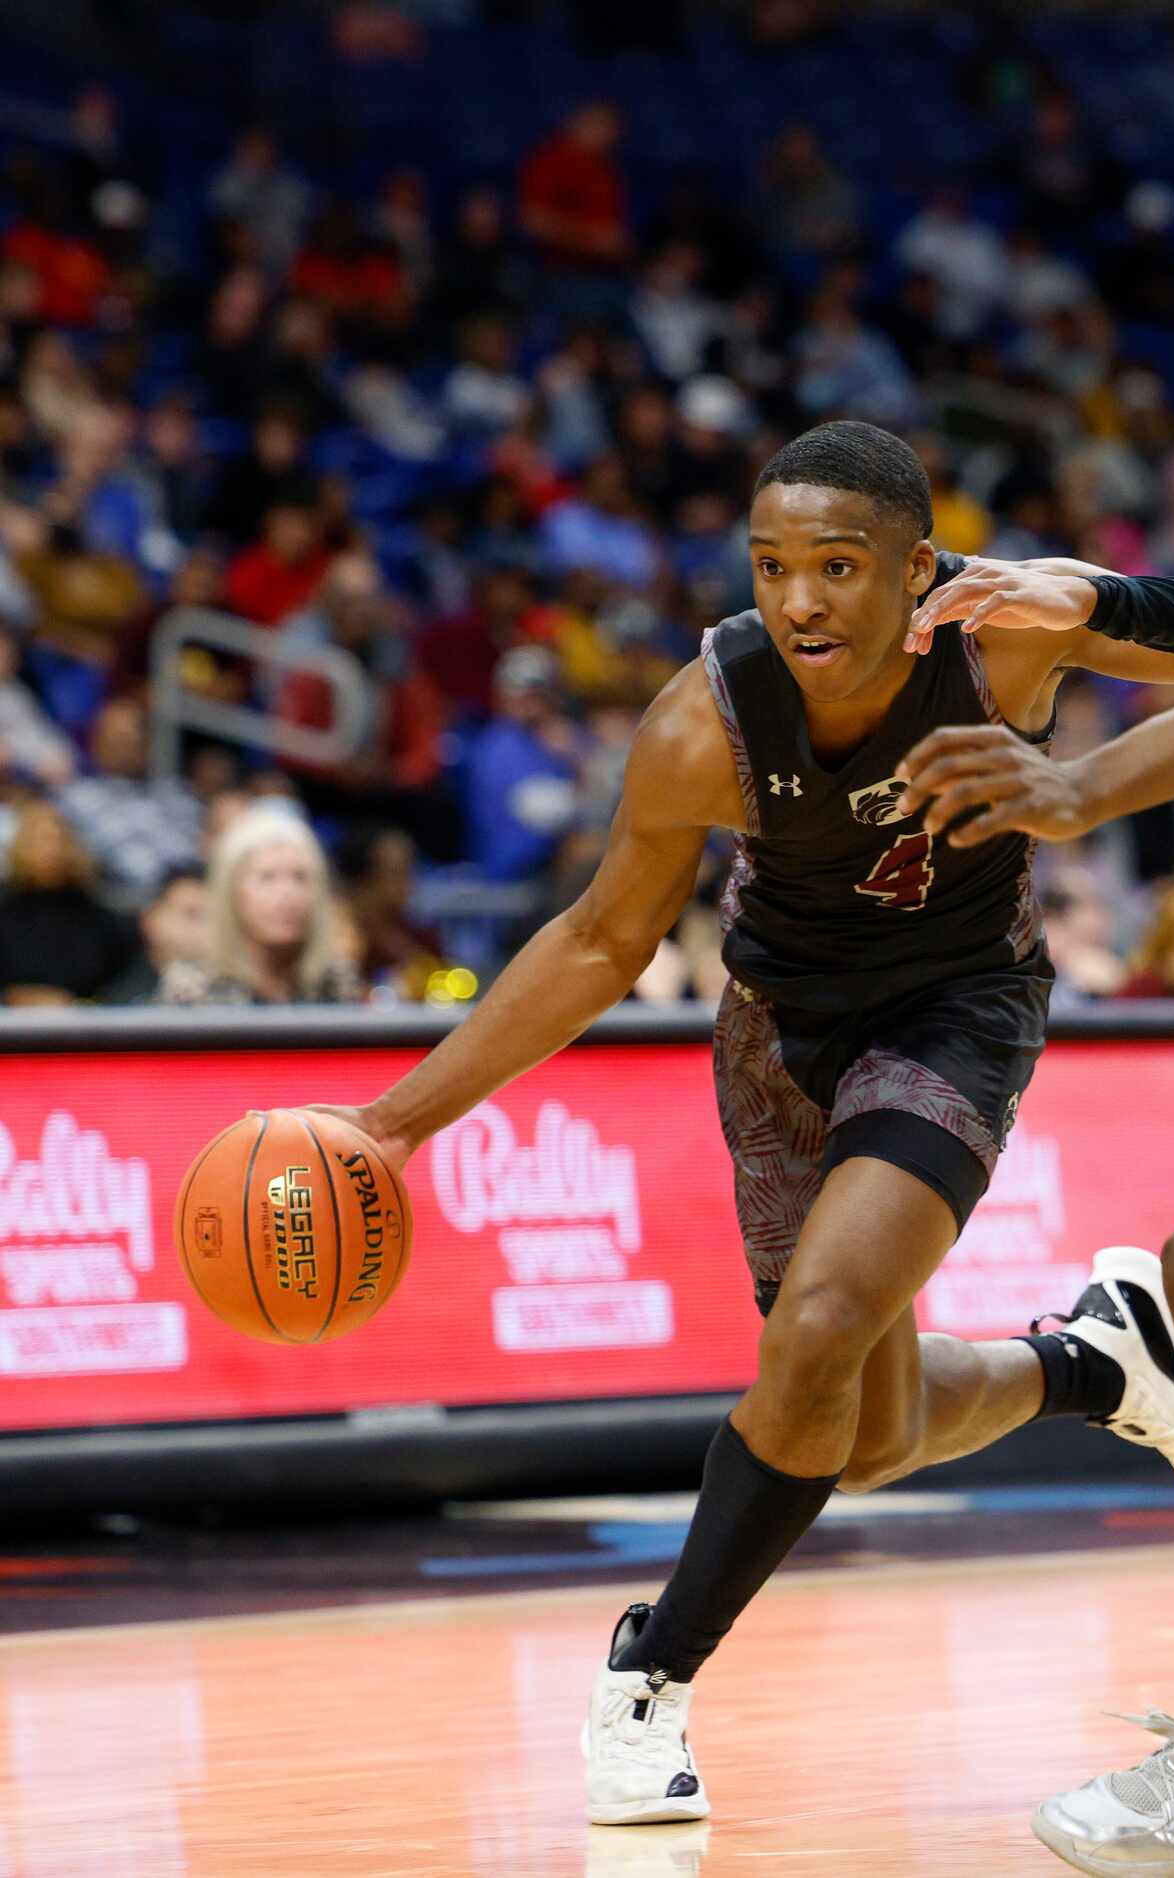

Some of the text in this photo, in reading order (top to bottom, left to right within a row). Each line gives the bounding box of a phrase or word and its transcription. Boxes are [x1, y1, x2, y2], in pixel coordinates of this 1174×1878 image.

[853, 831, 934, 911] 4
[273, 1209, 292, 1290] 1000
[285, 1165, 321, 1299] LEGACY
[336, 1150, 384, 1304] SPALDING
